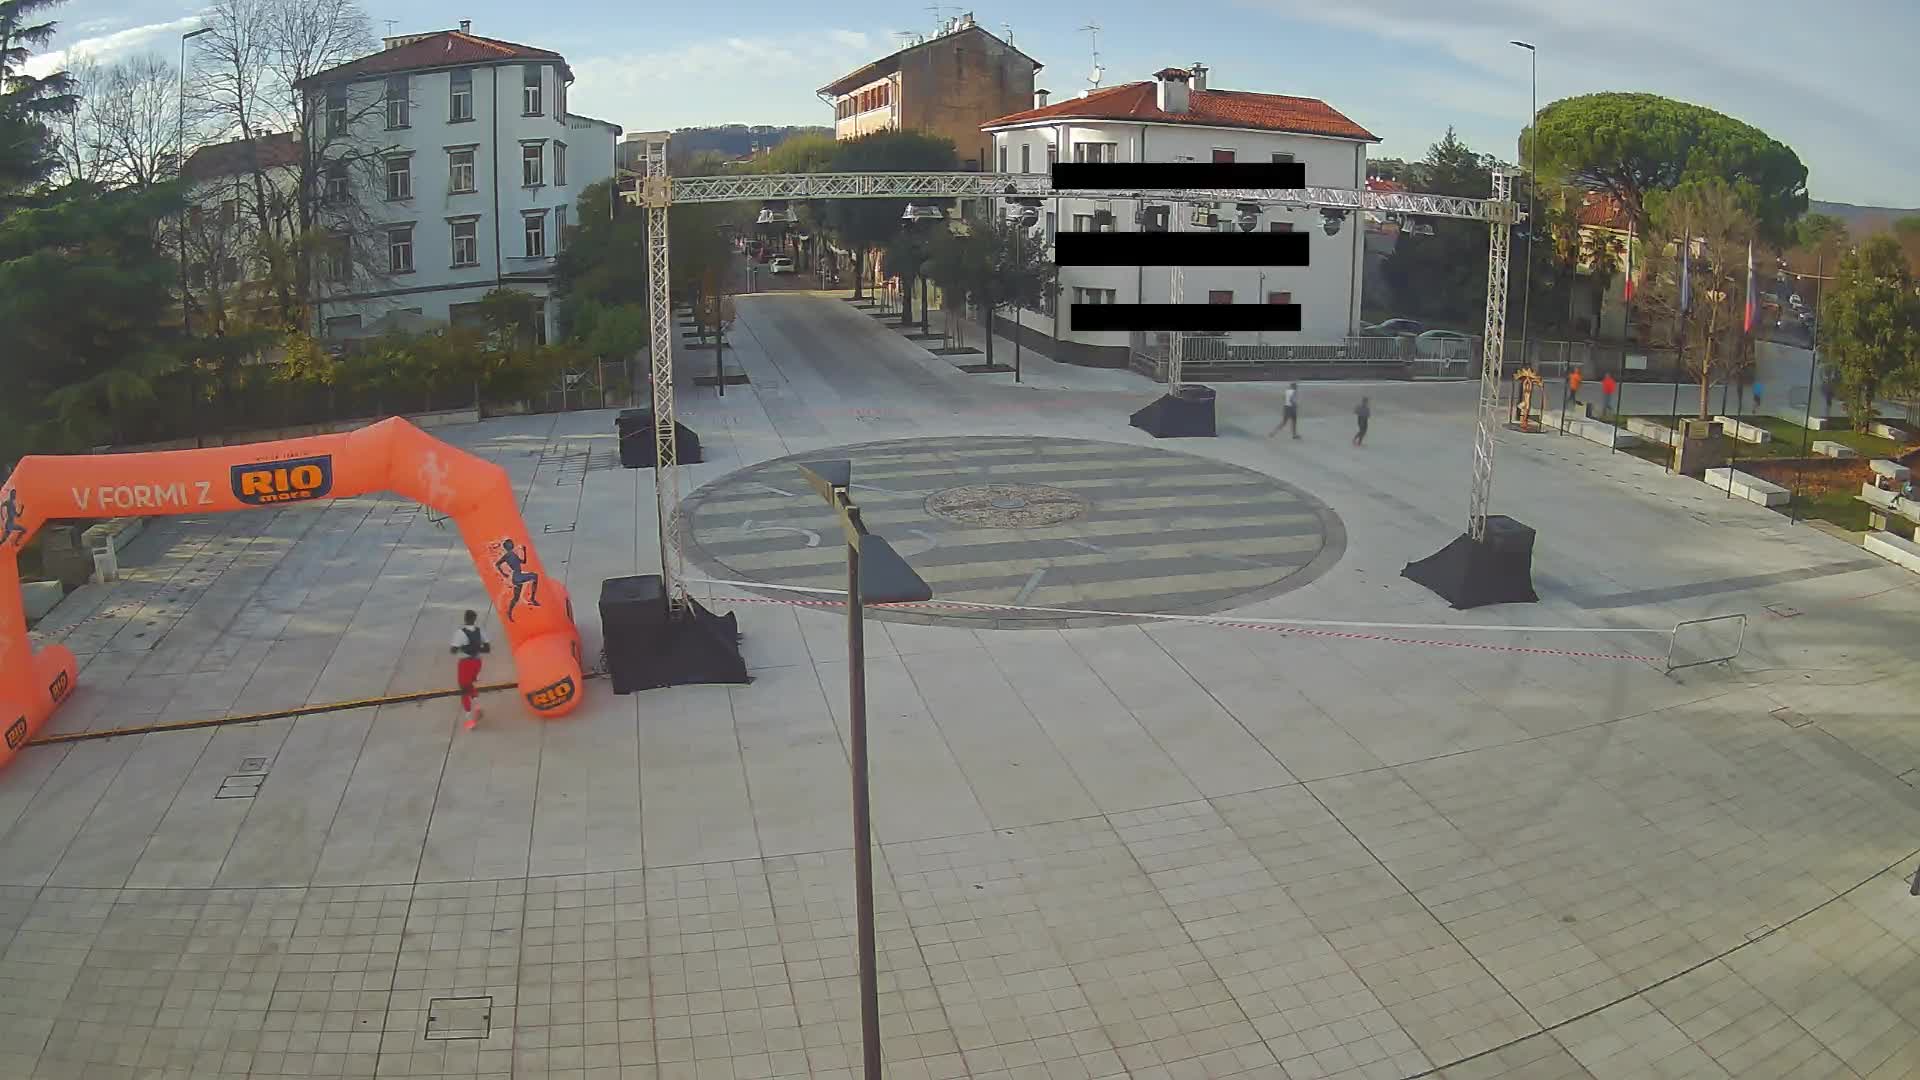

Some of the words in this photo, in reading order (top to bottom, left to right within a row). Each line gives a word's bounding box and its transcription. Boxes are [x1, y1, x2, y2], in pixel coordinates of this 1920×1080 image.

[241, 465, 322, 496] RIO
[71, 487, 91, 511] V
[97, 482, 188, 511] FORMI
[194, 481, 214, 505] Z
[533, 682, 571, 705] RIO
